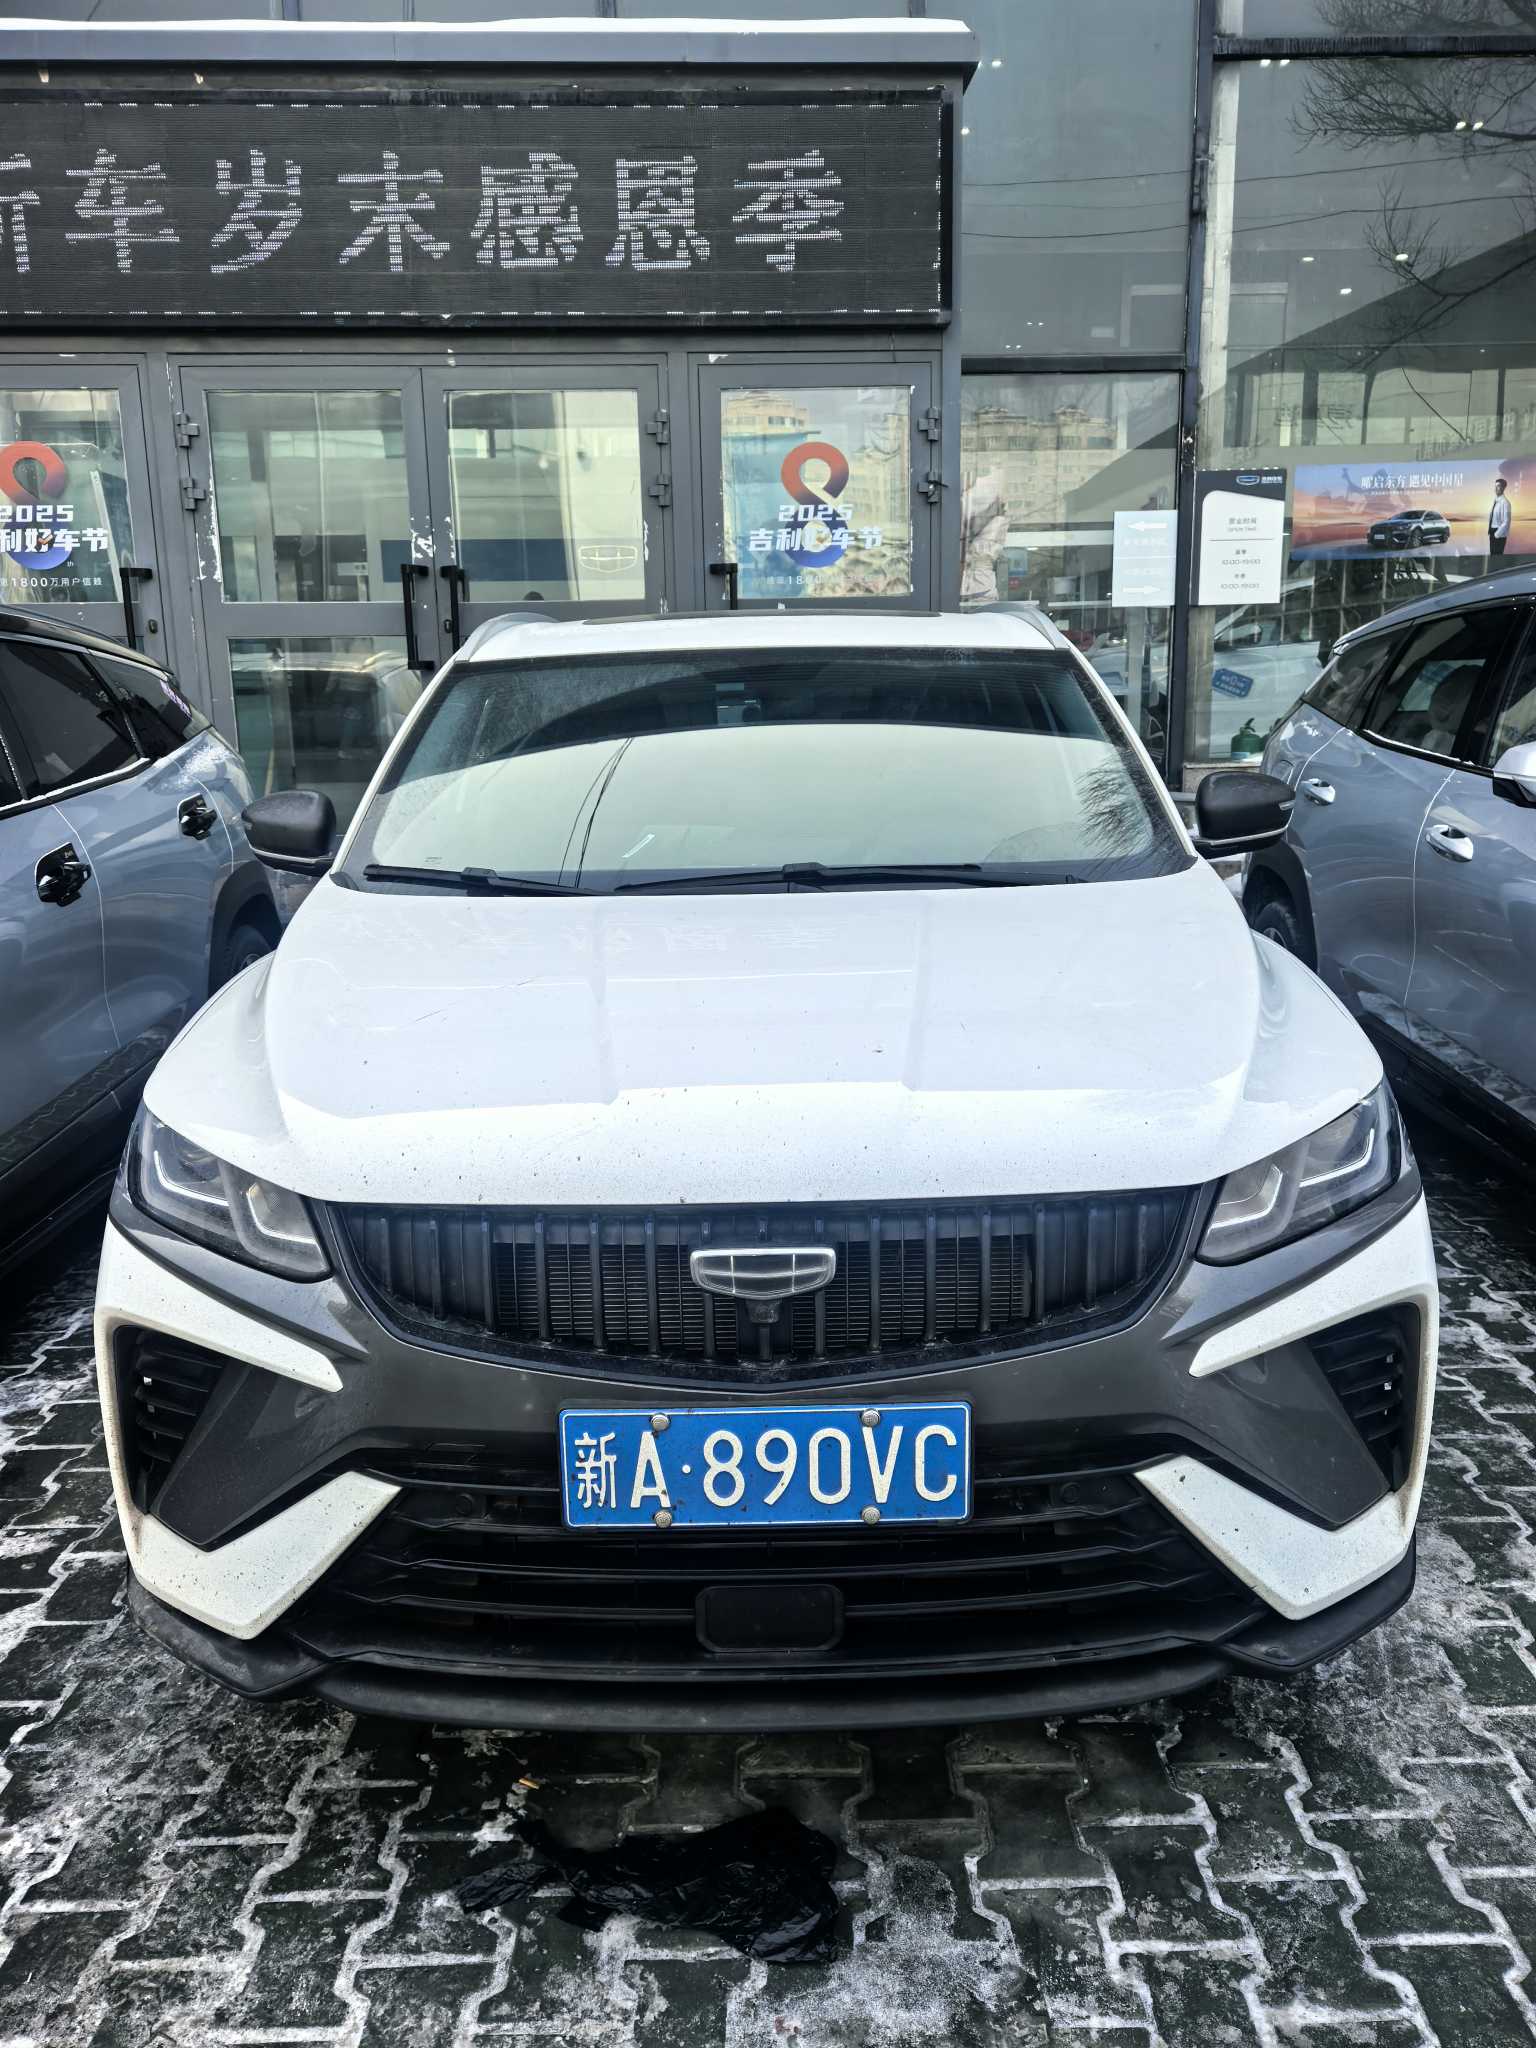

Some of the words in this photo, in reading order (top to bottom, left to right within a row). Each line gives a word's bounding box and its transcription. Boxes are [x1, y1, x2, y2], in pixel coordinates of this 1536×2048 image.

[0, 504, 74, 523] 2025
[778, 503, 854, 522] 2025
[575, 1425, 958, 1509] 新A·890VC
